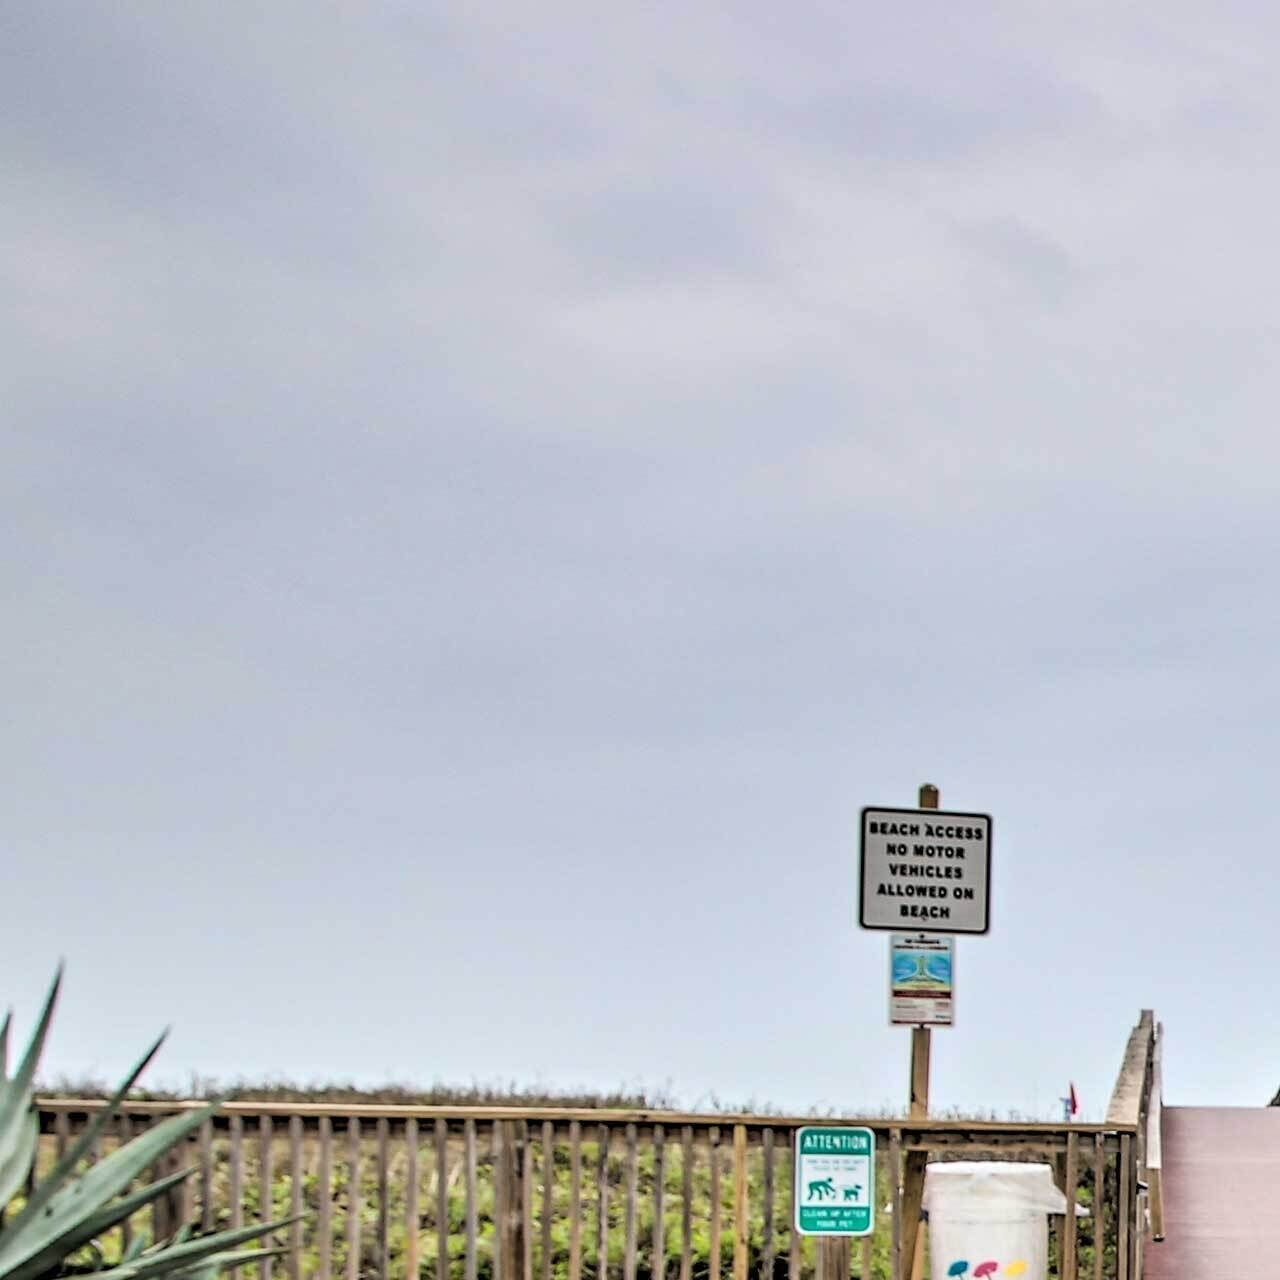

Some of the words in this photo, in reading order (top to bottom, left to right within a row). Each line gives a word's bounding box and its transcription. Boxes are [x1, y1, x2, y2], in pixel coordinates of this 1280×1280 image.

[870, 822, 919, 835] BEACH
[925, 825, 983, 840] ACCESS
[886, 844, 907, 856] NO
[913, 845, 965, 859] MOTOR
[889, 864, 962, 879] VEHICLES
[877, 883, 947, 898] ALLOWED
[953, 888, 974, 899] ON
[900, 905, 950, 919] BEACH
[804, 1135, 867, 1149] ATTENTION
[802, 1209, 827, 1217] CLEAN
